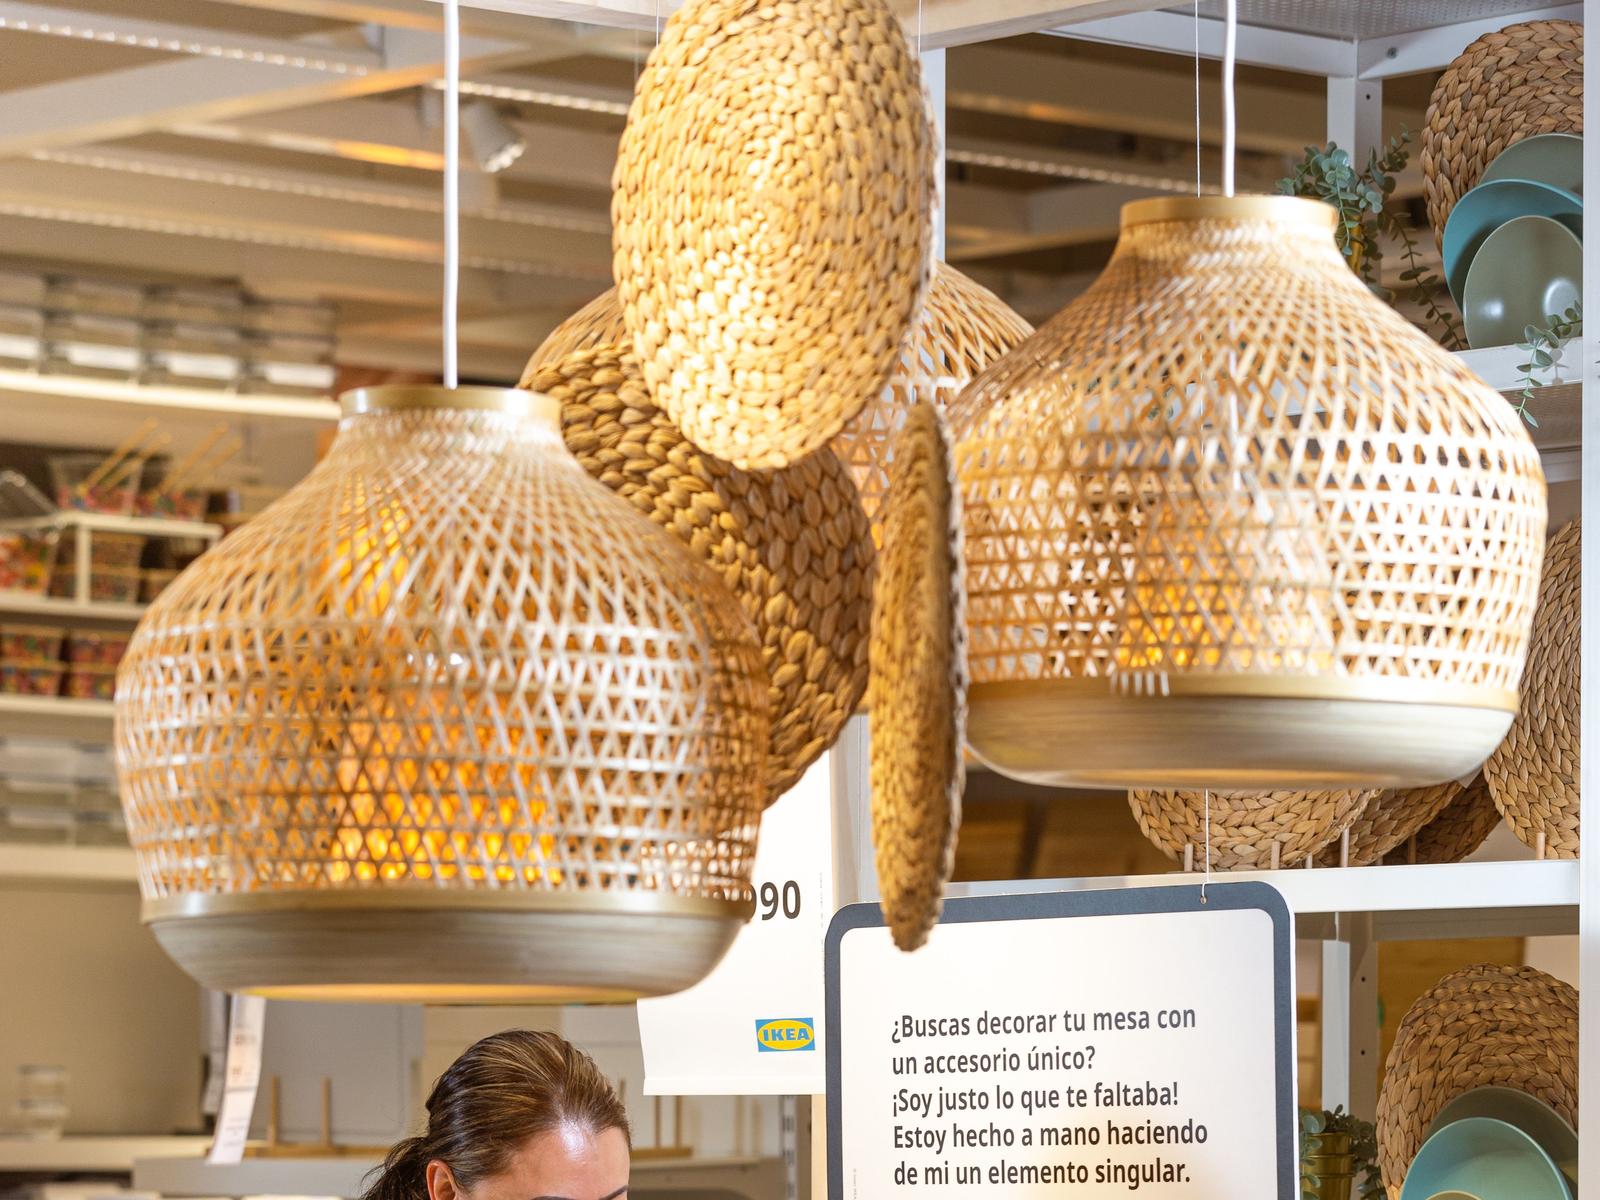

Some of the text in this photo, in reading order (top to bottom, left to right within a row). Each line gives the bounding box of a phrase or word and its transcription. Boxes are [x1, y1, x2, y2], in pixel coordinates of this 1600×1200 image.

[751, 880, 801, 921] 90
[763, 1028, 810, 1041] IKEA
[891, 1008, 1196, 1044] ¿Buscas decorar tu mesa con
[892, 1045, 1096, 1076] un accesorio único?
[892, 1080, 1178, 1119] ¡Soy justo lo que te faltaba!
[893, 1117, 1208, 1156] Estoy hecho a mano haciendo
[893, 1156, 1191, 1191] de mi un elemento singular.
